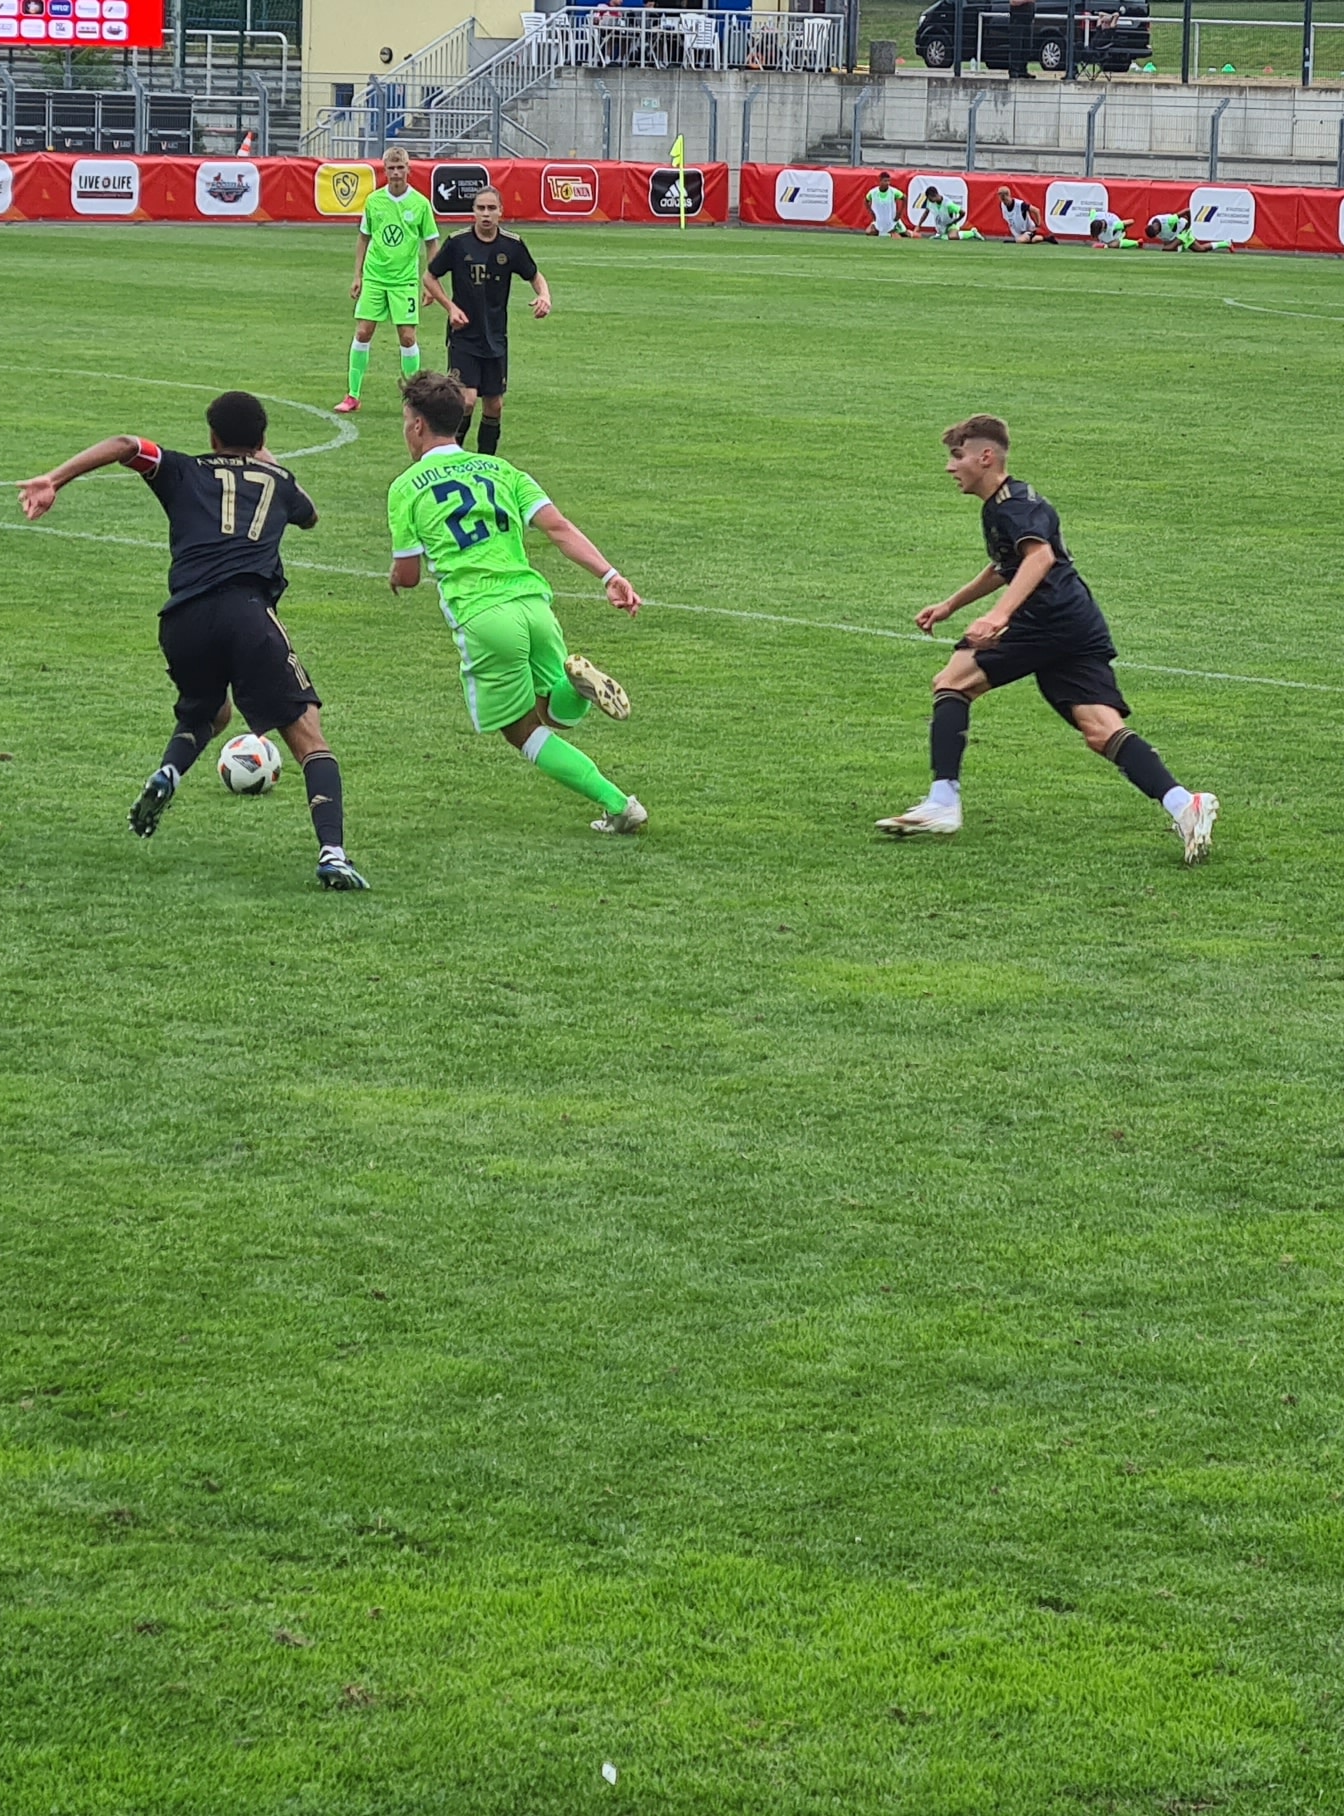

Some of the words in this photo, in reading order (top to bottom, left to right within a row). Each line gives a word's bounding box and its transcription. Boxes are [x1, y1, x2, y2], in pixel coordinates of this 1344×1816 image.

[79, 176, 100, 189] LIVE
[112, 176, 132, 189] LIFE
[336, 175, 356, 196] FSV
[214, 468, 275, 541] 17
[431, 474, 509, 551] 21
